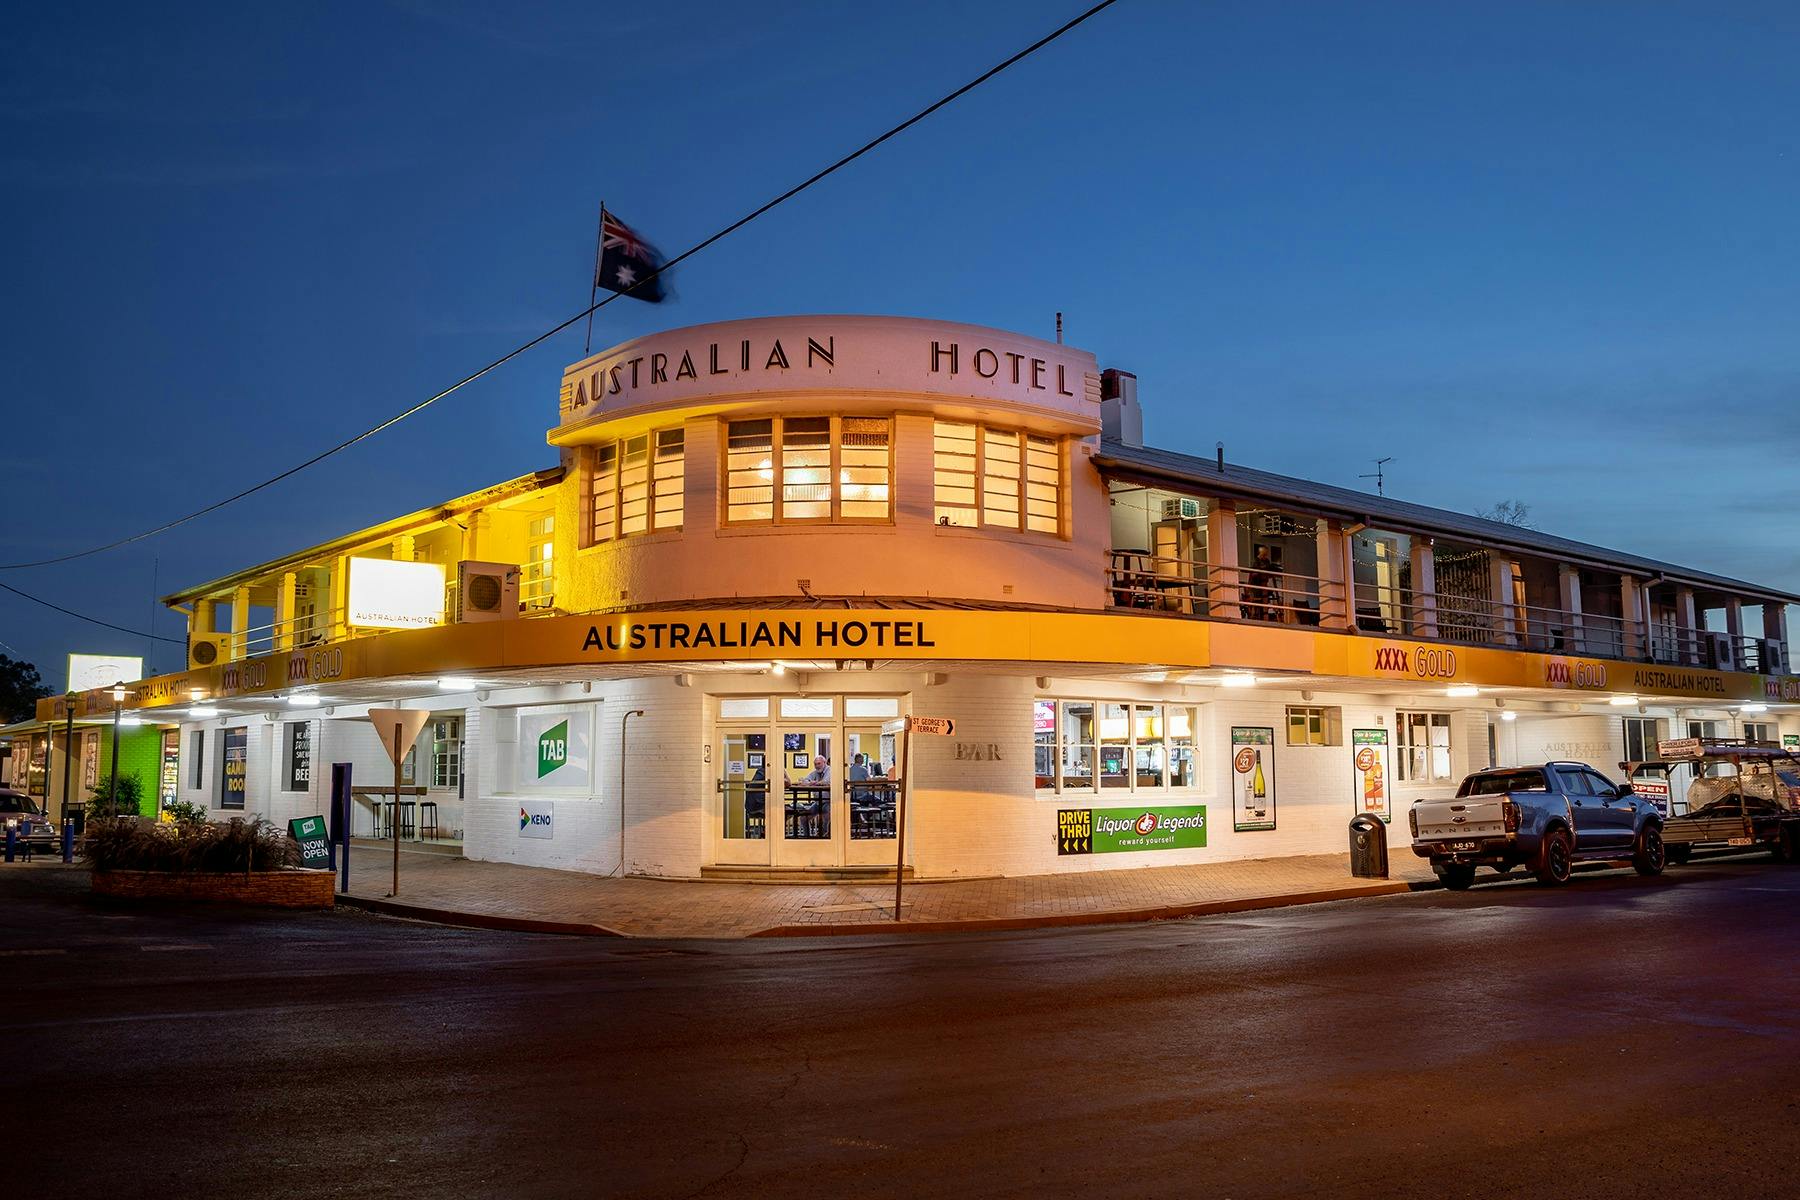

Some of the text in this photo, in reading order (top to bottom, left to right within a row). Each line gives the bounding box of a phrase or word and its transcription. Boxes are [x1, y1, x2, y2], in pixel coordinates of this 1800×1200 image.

[573, 336, 1074, 410] AUSTRALIAN HOTEL
[356, 612, 438, 624] AUSTRALIAN HOTEL
[582, 621, 936, 650] AUSTRALIAN HOTEL
[288, 647, 343, 682] XXXX GOLD
[1375, 646, 1456, 677] XXXX GOLD
[223, 661, 267, 691] XXXX GOLD
[1546, 661, 1608, 688] XXXX GOLD
[1634, 670, 1726, 693] AUSTRALIAN HOTEL
[917, 725, 940, 734] TERRACE
[921, 719, 946, 727] GEORGE'S
[541, 739, 565, 761] TAB
[954, 743, 1002, 760] BAR
[1632, 784, 1664, 794] OPEN
[531, 815, 551, 826] KENO
[1059, 811, 1090, 824] DRIVE
[1096, 812, 1204, 836] Liquor Legends
[303, 823, 315, 831] TAB
[1060, 824, 1091, 839] THRU
[1421, 826, 1501, 835] RANGER
[303, 840, 325, 850] NOW
[1118, 836, 1175, 846] reward yourself
[303, 848, 329, 859] OPEN
